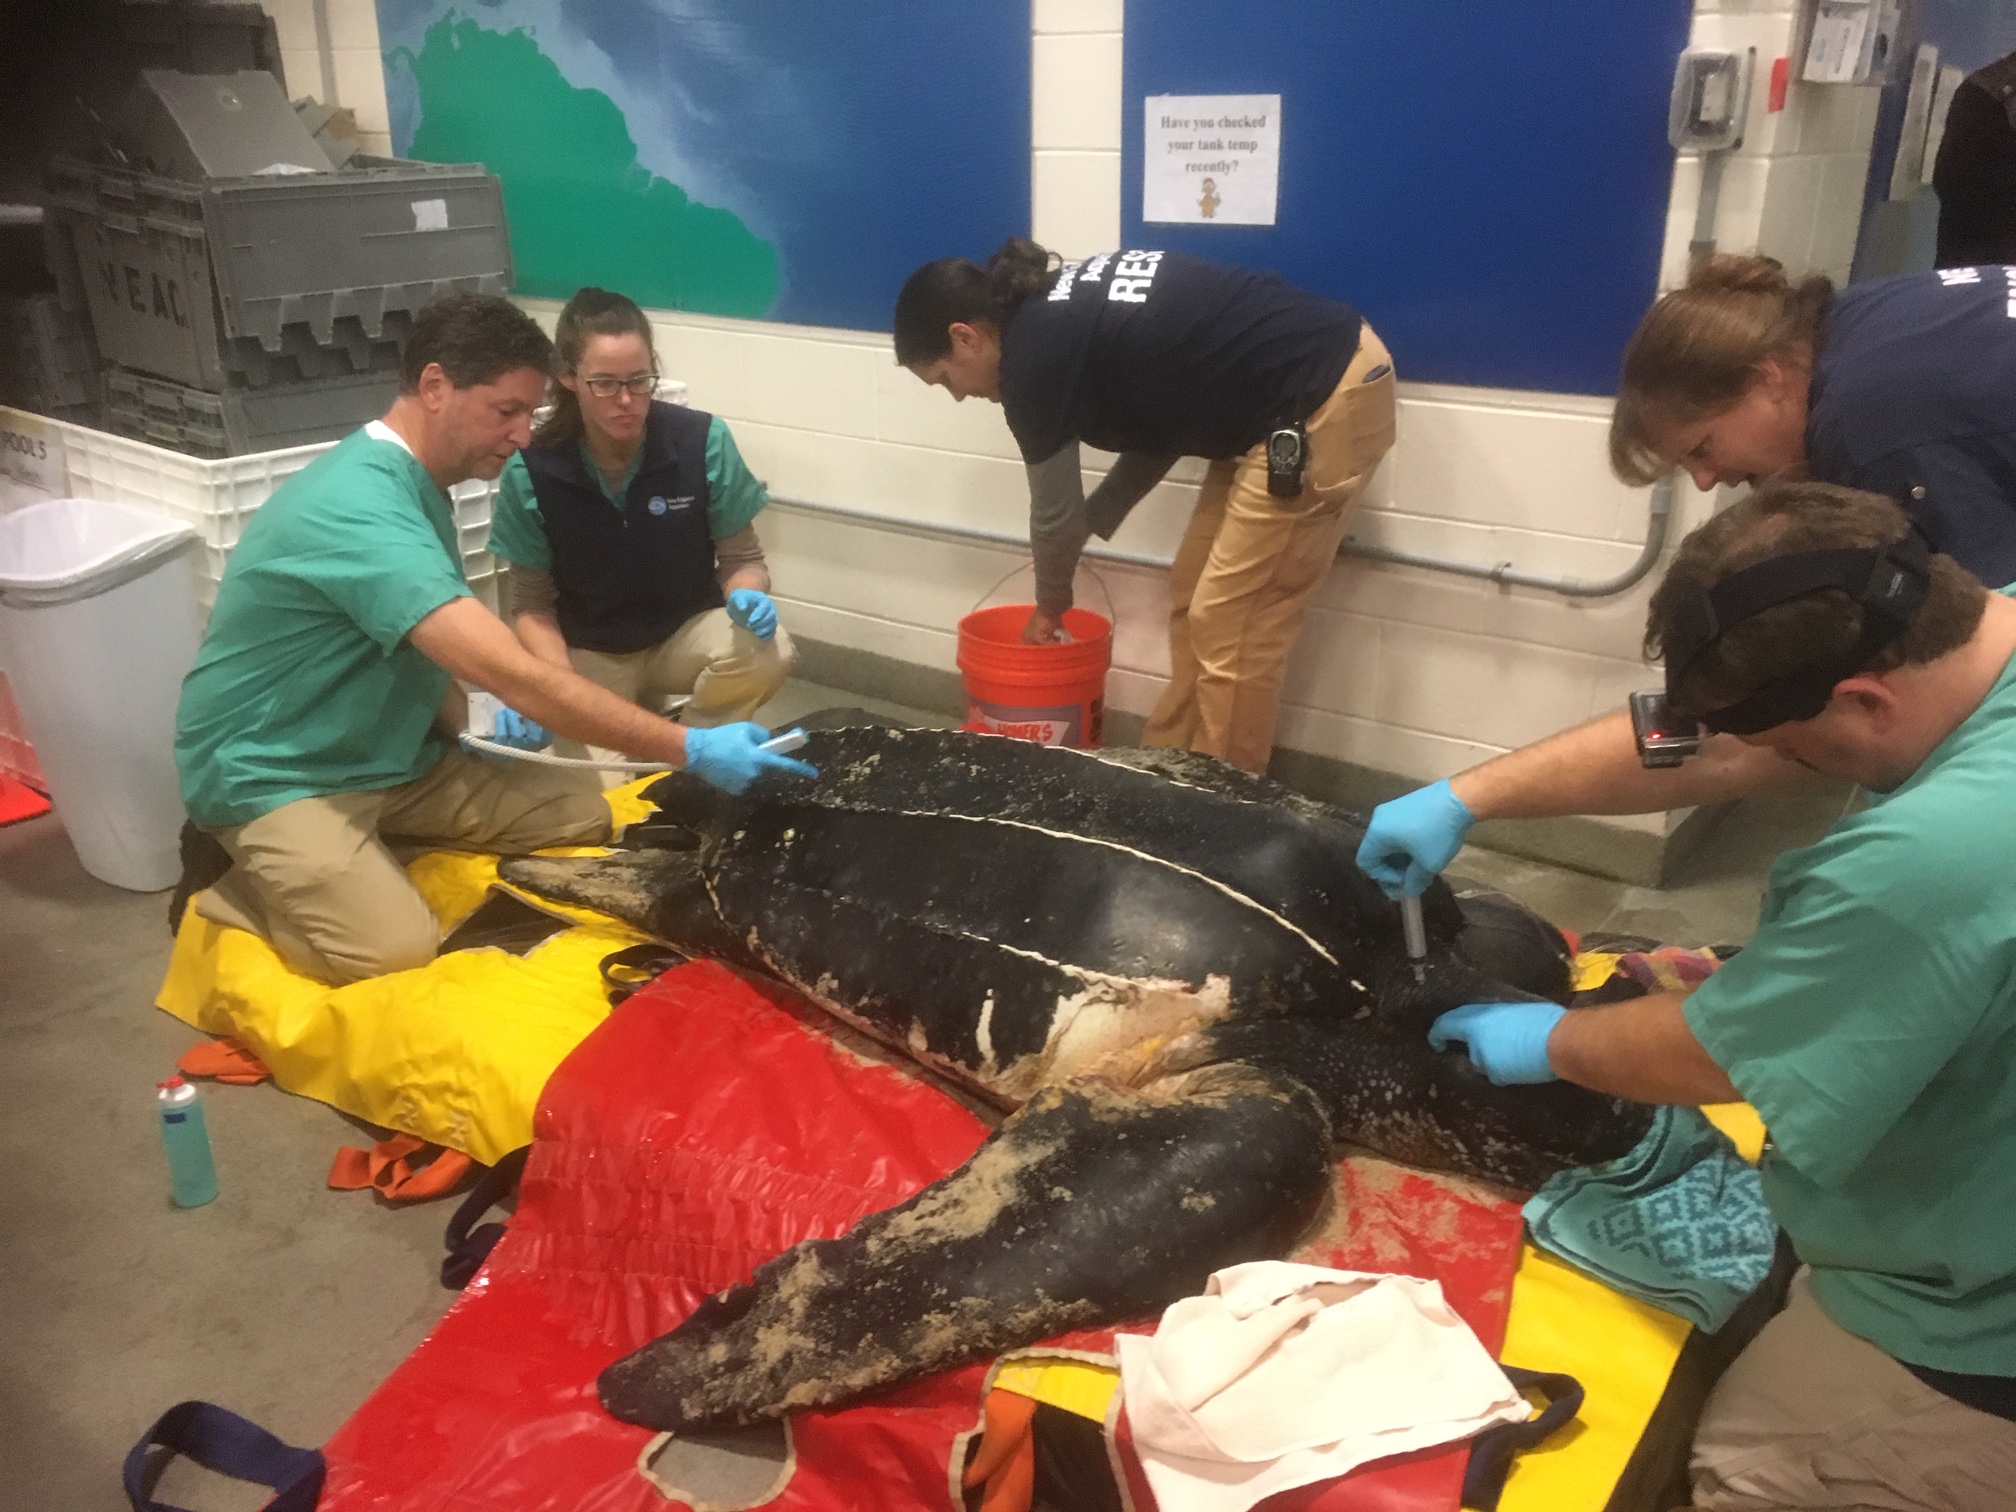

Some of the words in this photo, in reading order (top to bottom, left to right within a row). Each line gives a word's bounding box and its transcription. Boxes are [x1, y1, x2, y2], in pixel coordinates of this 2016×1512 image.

[1160, 115, 1190, 129] Have
[1193, 118, 1215, 132] you
[1217, 115, 1266, 129] checked
[1167, 140, 1195, 154] your
[1198, 138, 1224, 151] tank
[1228, 139, 1258, 154] temp
[1184, 159, 1239, 176] recently?
